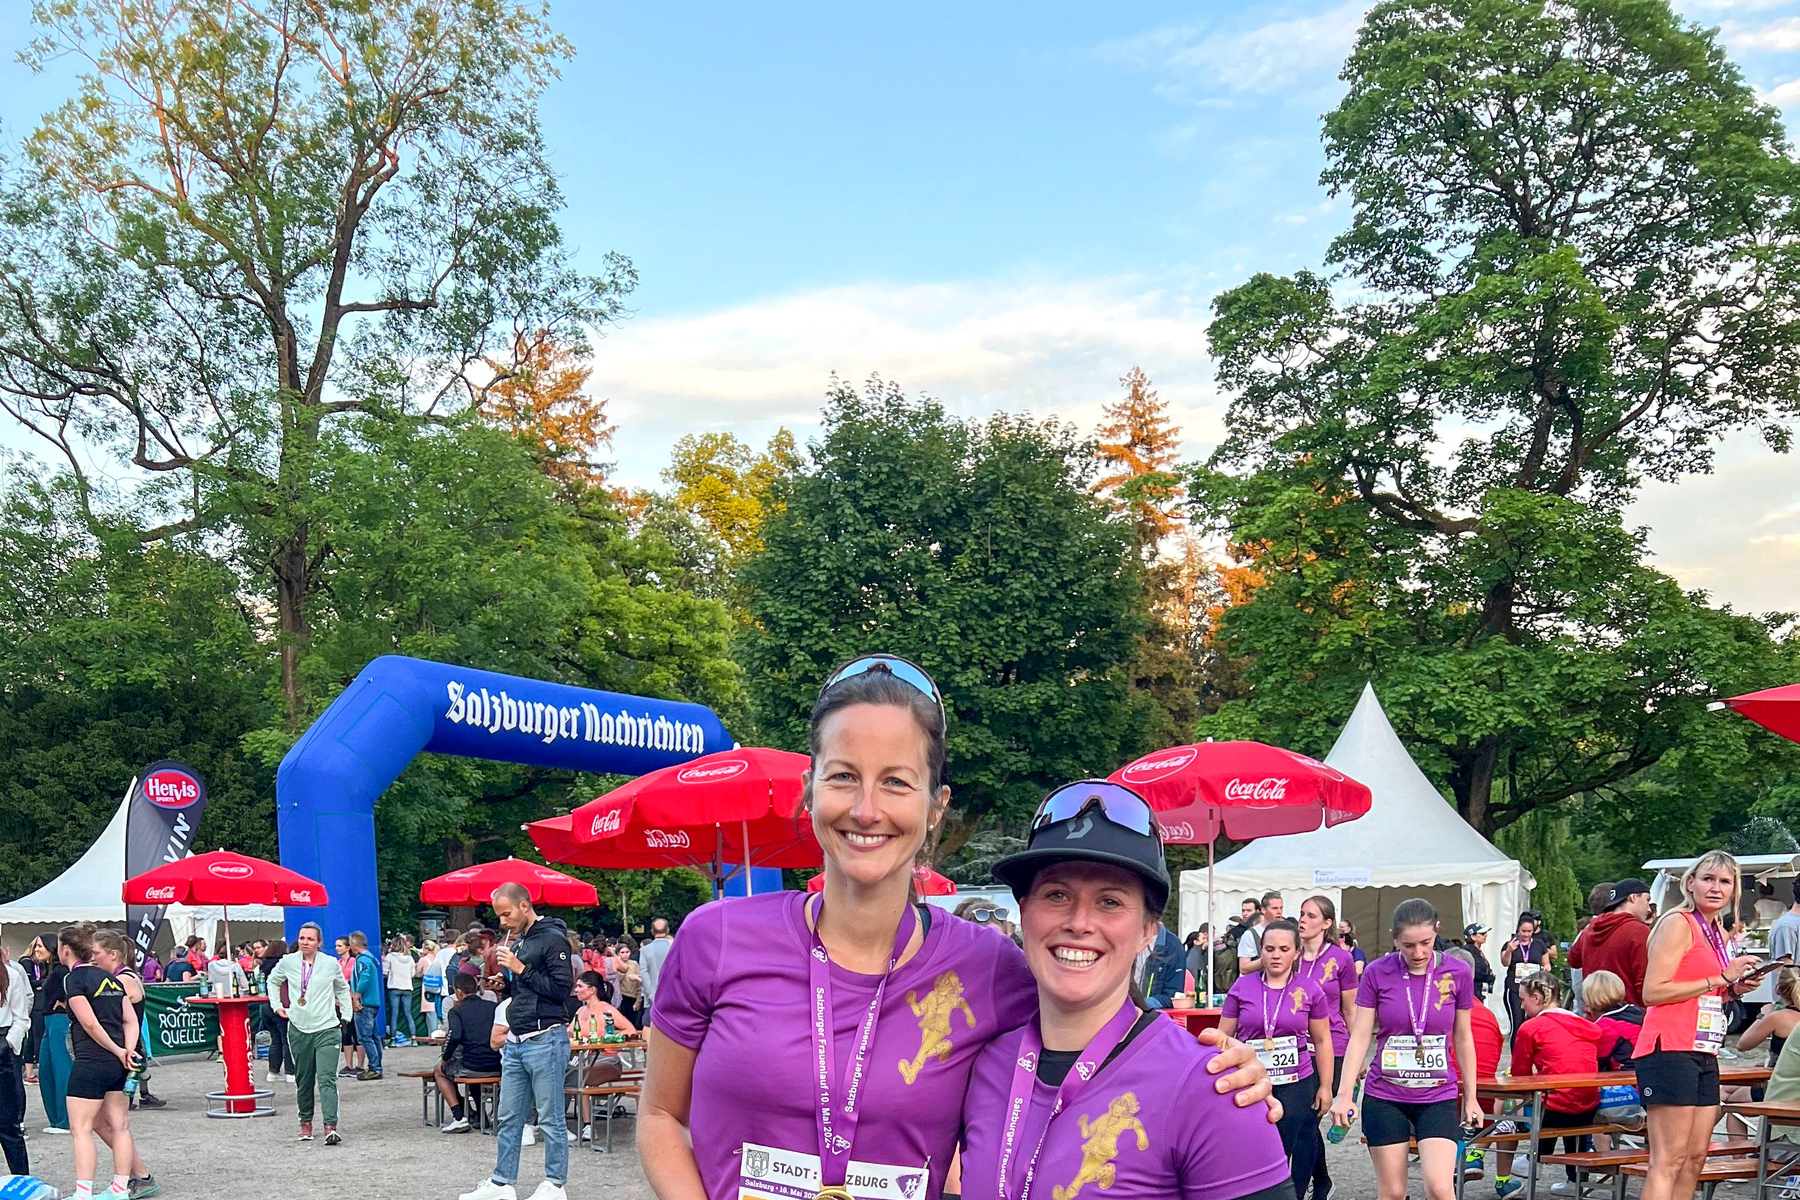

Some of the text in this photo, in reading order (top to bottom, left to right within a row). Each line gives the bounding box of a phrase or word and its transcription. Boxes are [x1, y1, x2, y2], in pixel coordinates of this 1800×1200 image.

[445, 680, 705, 754] Salzburger Nachrichten
[148, 778, 196, 801] Hervis
[1225, 778, 1290, 800] Coca-Cola
[135, 913, 156, 968] GET
[816, 988, 825, 1037] Salzburger
[161, 1028, 206, 1048] QUELLE
[818, 1038, 830, 1090] Frauenlauf
[844, 1061, 863, 1113] Salzburger
[855, 1012, 875, 1061] Frauenlauf
[1272, 1053, 1296, 1066] 324
[1416, 1053, 1444, 1069] 496
[1398, 1070, 1431, 1078] Verena
[822, 1107, 830, 1125] Mai
[1006, 1097, 1024, 1147] Salzburger
[773, 1161, 811, 1179] STADT
[998, 1148, 1013, 1198] Frauenlauf
[744, 1178, 775, 1192] Salzburg
[790, 1189, 802, 1198] Mai
